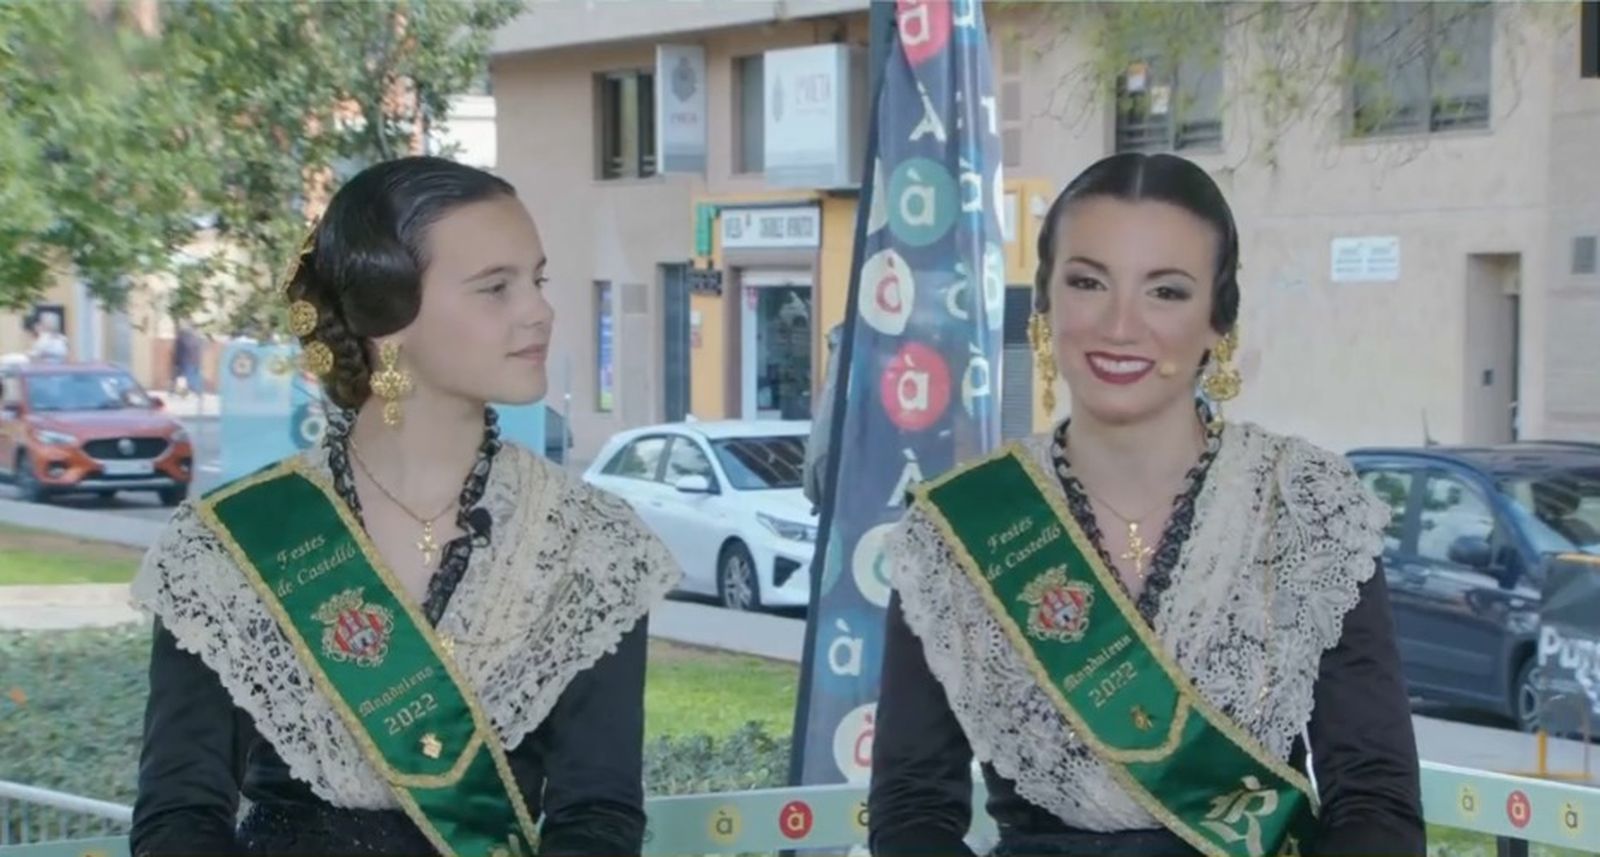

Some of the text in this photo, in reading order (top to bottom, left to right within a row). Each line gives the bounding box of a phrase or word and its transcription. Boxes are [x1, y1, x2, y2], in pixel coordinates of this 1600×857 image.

[901, 168, 935, 226] à
[897, 353, 930, 411] à
[277, 534, 326, 570] Festes
[986, 516, 1033, 555] Festes
[277, 579, 294, 598] de
[987, 563, 1003, 581] de
[828, 618, 864, 677] à
[1087, 660, 1138, 708] 2022
[383, 692, 439, 736] 2022
[715, 809, 734, 836] à
[786, 805, 805, 832] à
